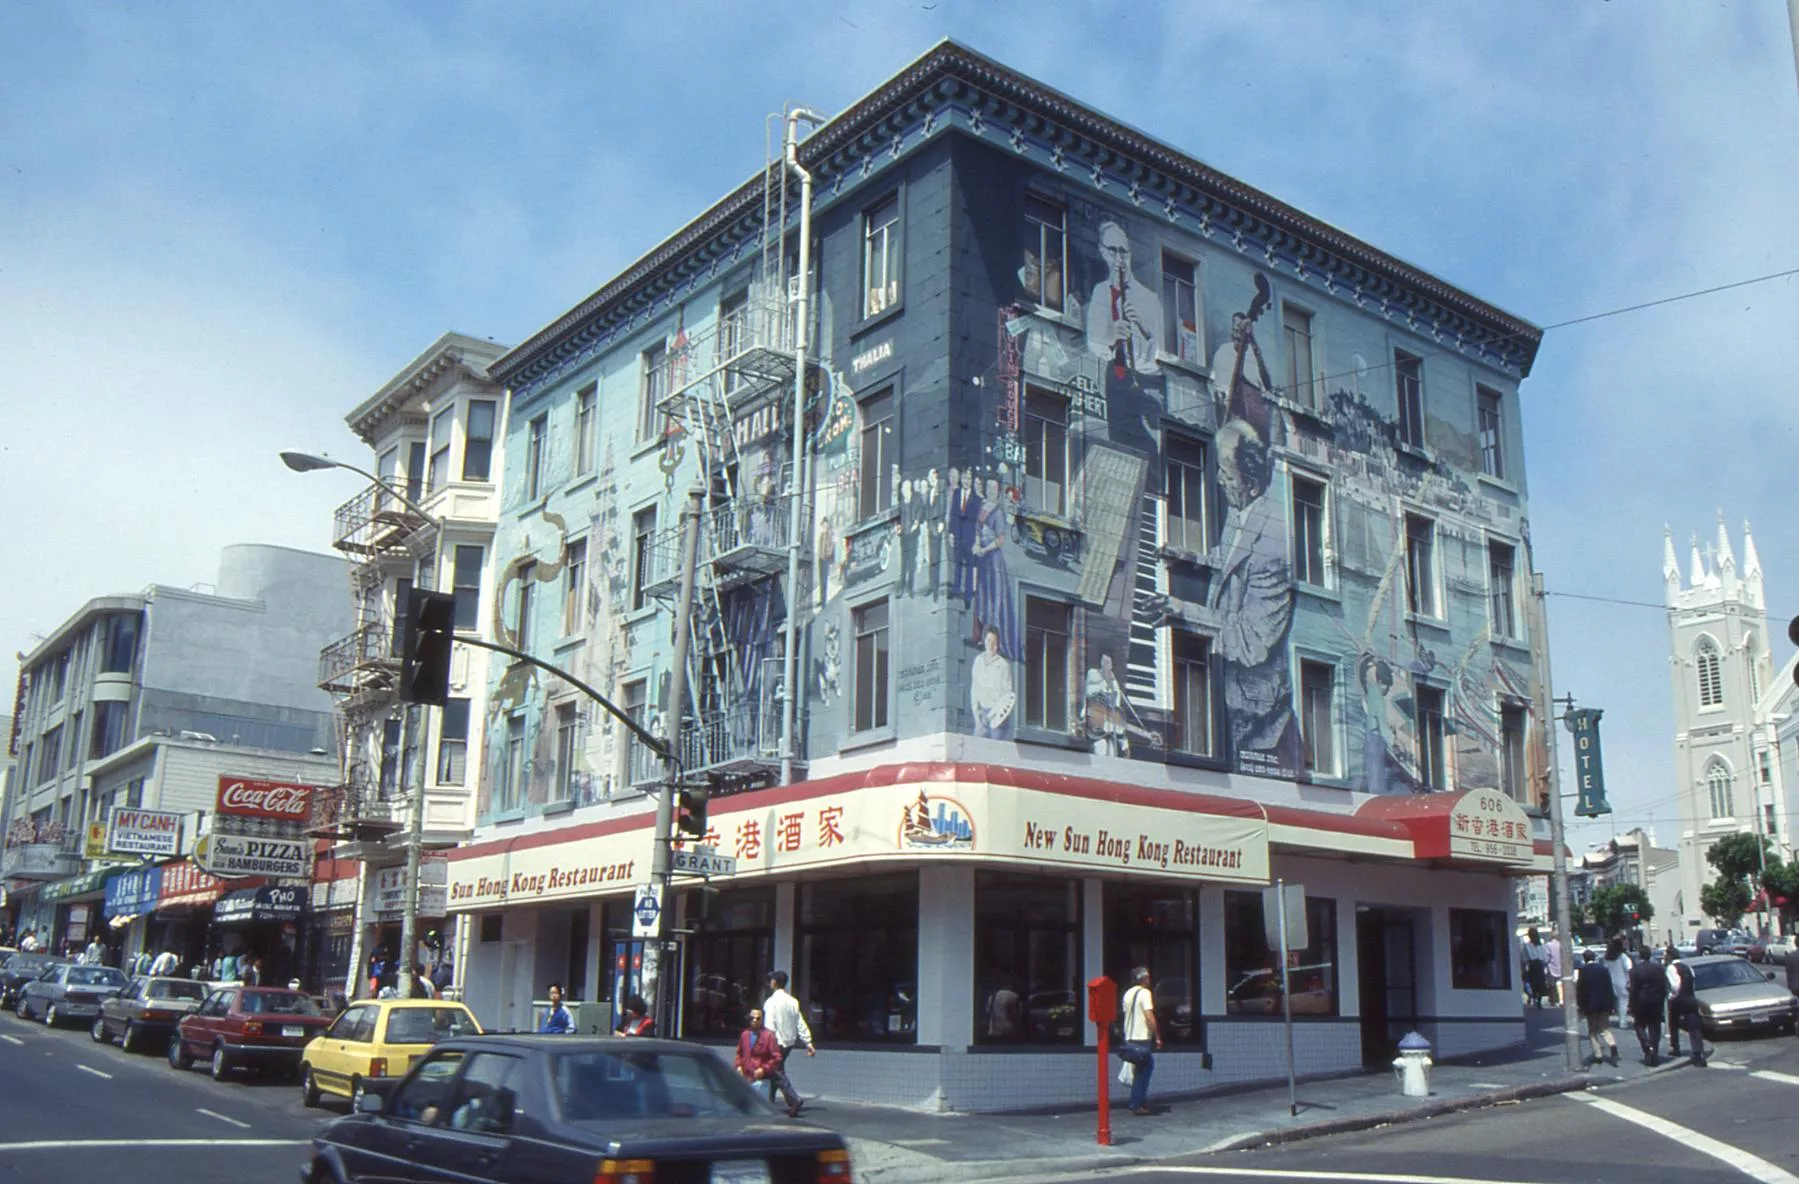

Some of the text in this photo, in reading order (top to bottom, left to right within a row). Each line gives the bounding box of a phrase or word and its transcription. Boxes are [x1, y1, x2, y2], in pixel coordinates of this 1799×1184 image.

[853, 340, 892, 373] THALIA
[1577, 716, 1594, 809] HOTEL
[223, 782, 309, 814] Coca-Cola
[1480, 796, 1503, 812] 606
[118, 811, 177, 833] MY CANH
[115, 840, 173, 852] RESTAURANT
[117, 831, 173, 843] VIETNAMESE
[1023, 821, 1242, 869] New Sun Hong Kong Restaurant
[245, 841, 303, 861] PIZZA
[228, 857, 300, 873] HAMBURGERS
[675, 854, 732, 873] GRANT
[451, 882, 472, 899] Sun
[476, 877, 508, 899] Hong
[511, 873, 545, 895] Kong
[548, 859, 635, 889] Restaurant
[268, 889, 295, 903] PHO
